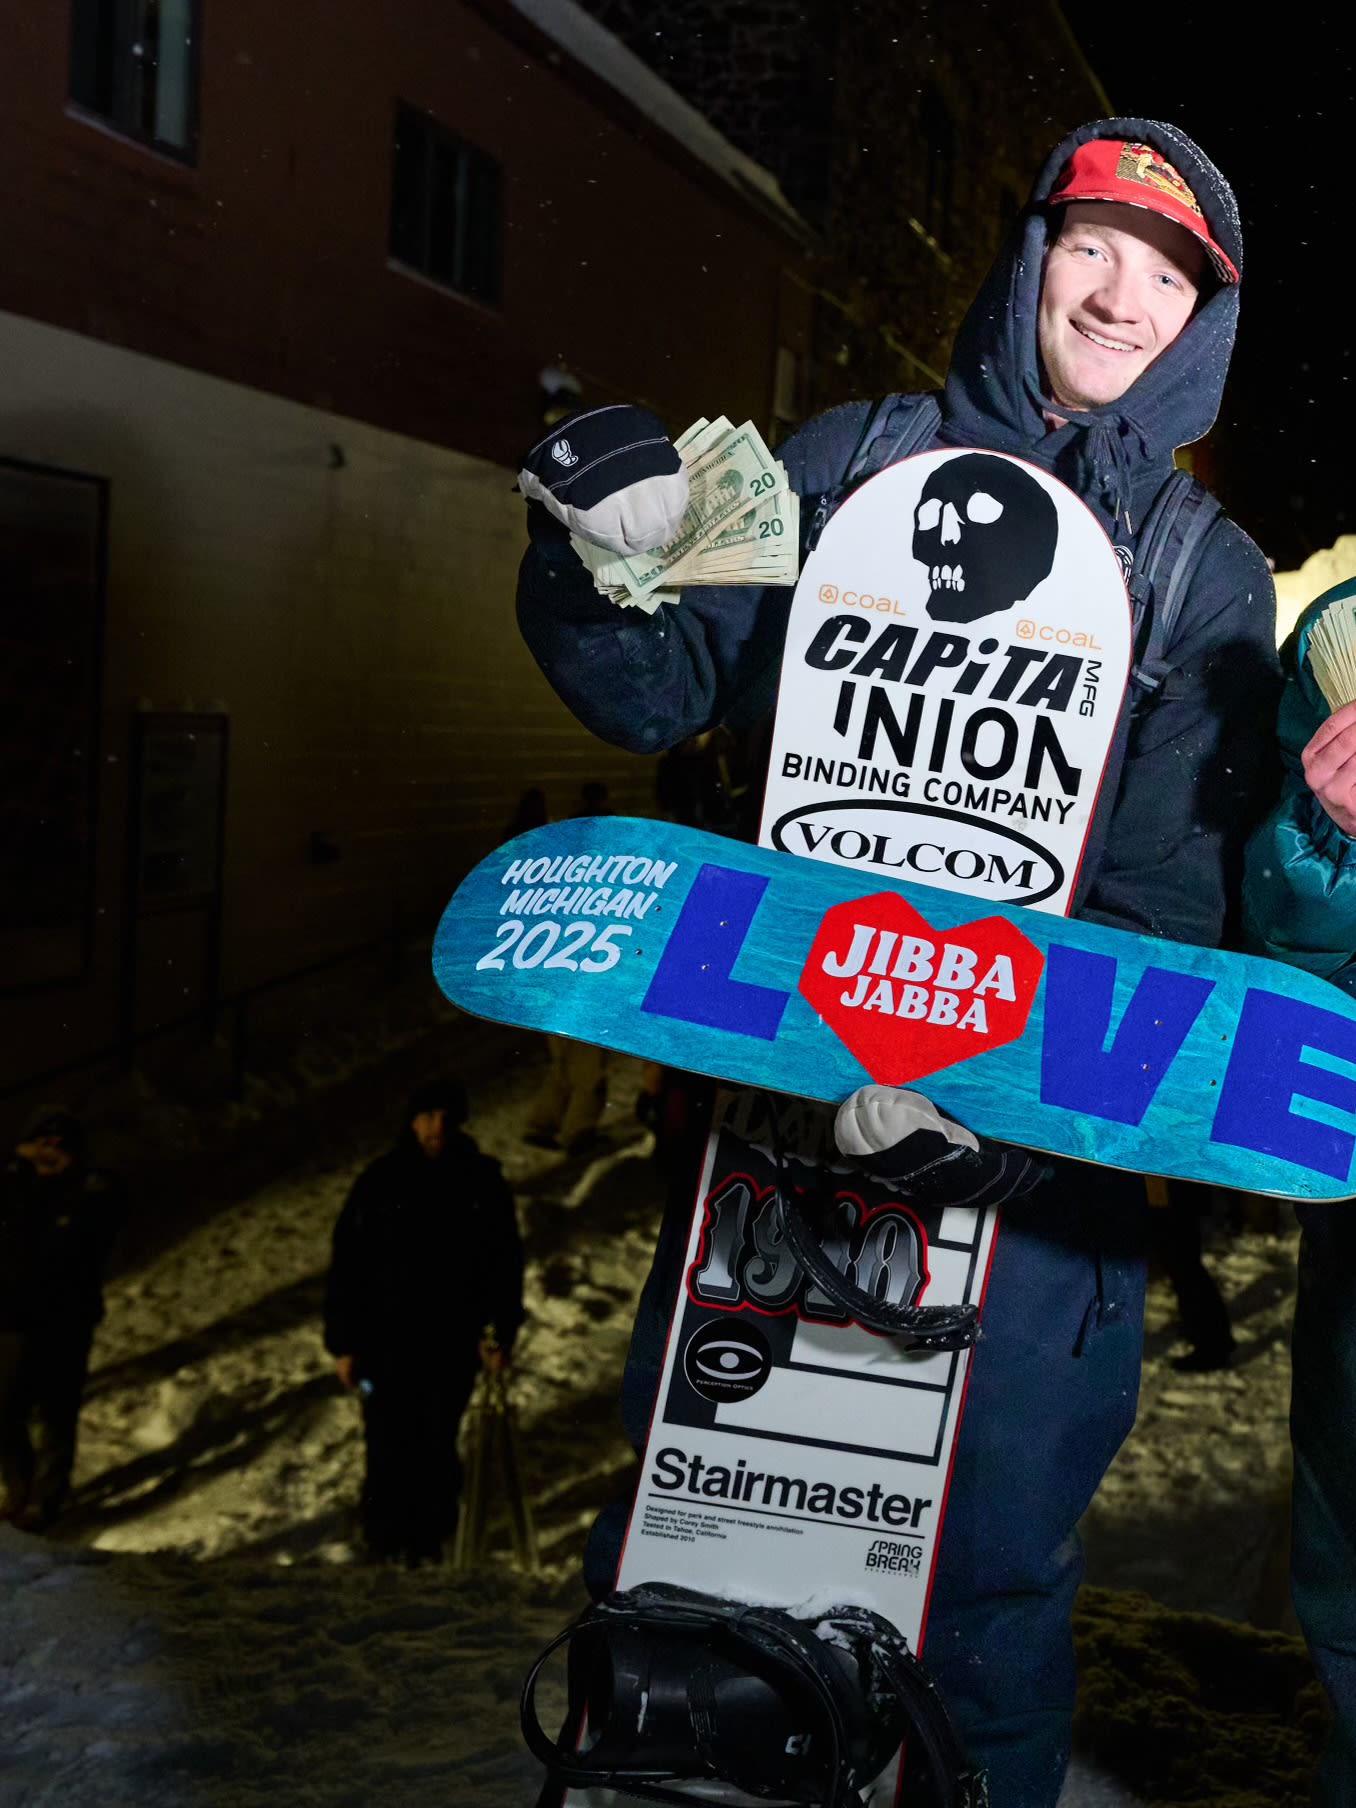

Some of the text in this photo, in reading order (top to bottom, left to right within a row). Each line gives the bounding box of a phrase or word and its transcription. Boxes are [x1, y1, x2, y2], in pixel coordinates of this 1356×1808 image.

[750, 472, 776, 498] 20
[758, 518, 784, 540] 20
[1079, 659, 1102, 717] MFG
[782, 752, 1076, 825] BINDING COMPANY
[502, 856, 677, 888] HOUGHTON
[796, 822, 1038, 890] VOLCOM
[500, 887, 657, 920] MICHIGAN
[476, 920, 633, 973] 2025
[822, 924, 1017, 1002] JIBBA
[841, 975, 989, 1034] JABBA
[651, 1447, 932, 1528] Stairmaster
[644, 1513, 669, 1522] Shaped
[680, 1519, 698, 1527] Corey
[700, 1522, 719, 1530] Smith
[646, 1505, 676, 1515] Designed
[641, 1529, 679, 1540] Established
[643, 1521, 664, 1529] Tested
[696, 1529, 727, 1539] California
[866, 1552, 921, 1574] BREAK
[869, 1540, 923, 1559] SPRING
